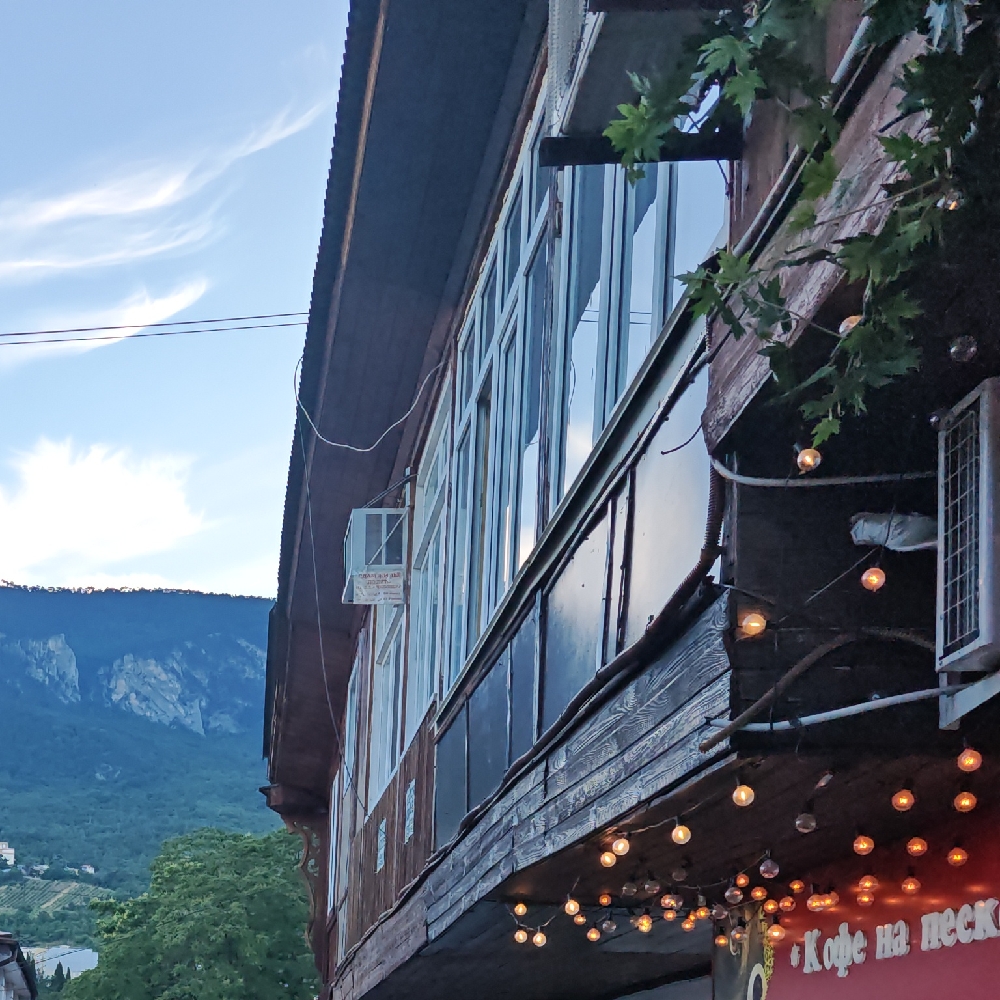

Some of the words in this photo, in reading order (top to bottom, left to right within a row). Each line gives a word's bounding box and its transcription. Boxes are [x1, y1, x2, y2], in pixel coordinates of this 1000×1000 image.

[802, 921, 868, 978] Кофе
[875, 919, 911, 960] на
[920, 897, 1000, 952] песк
